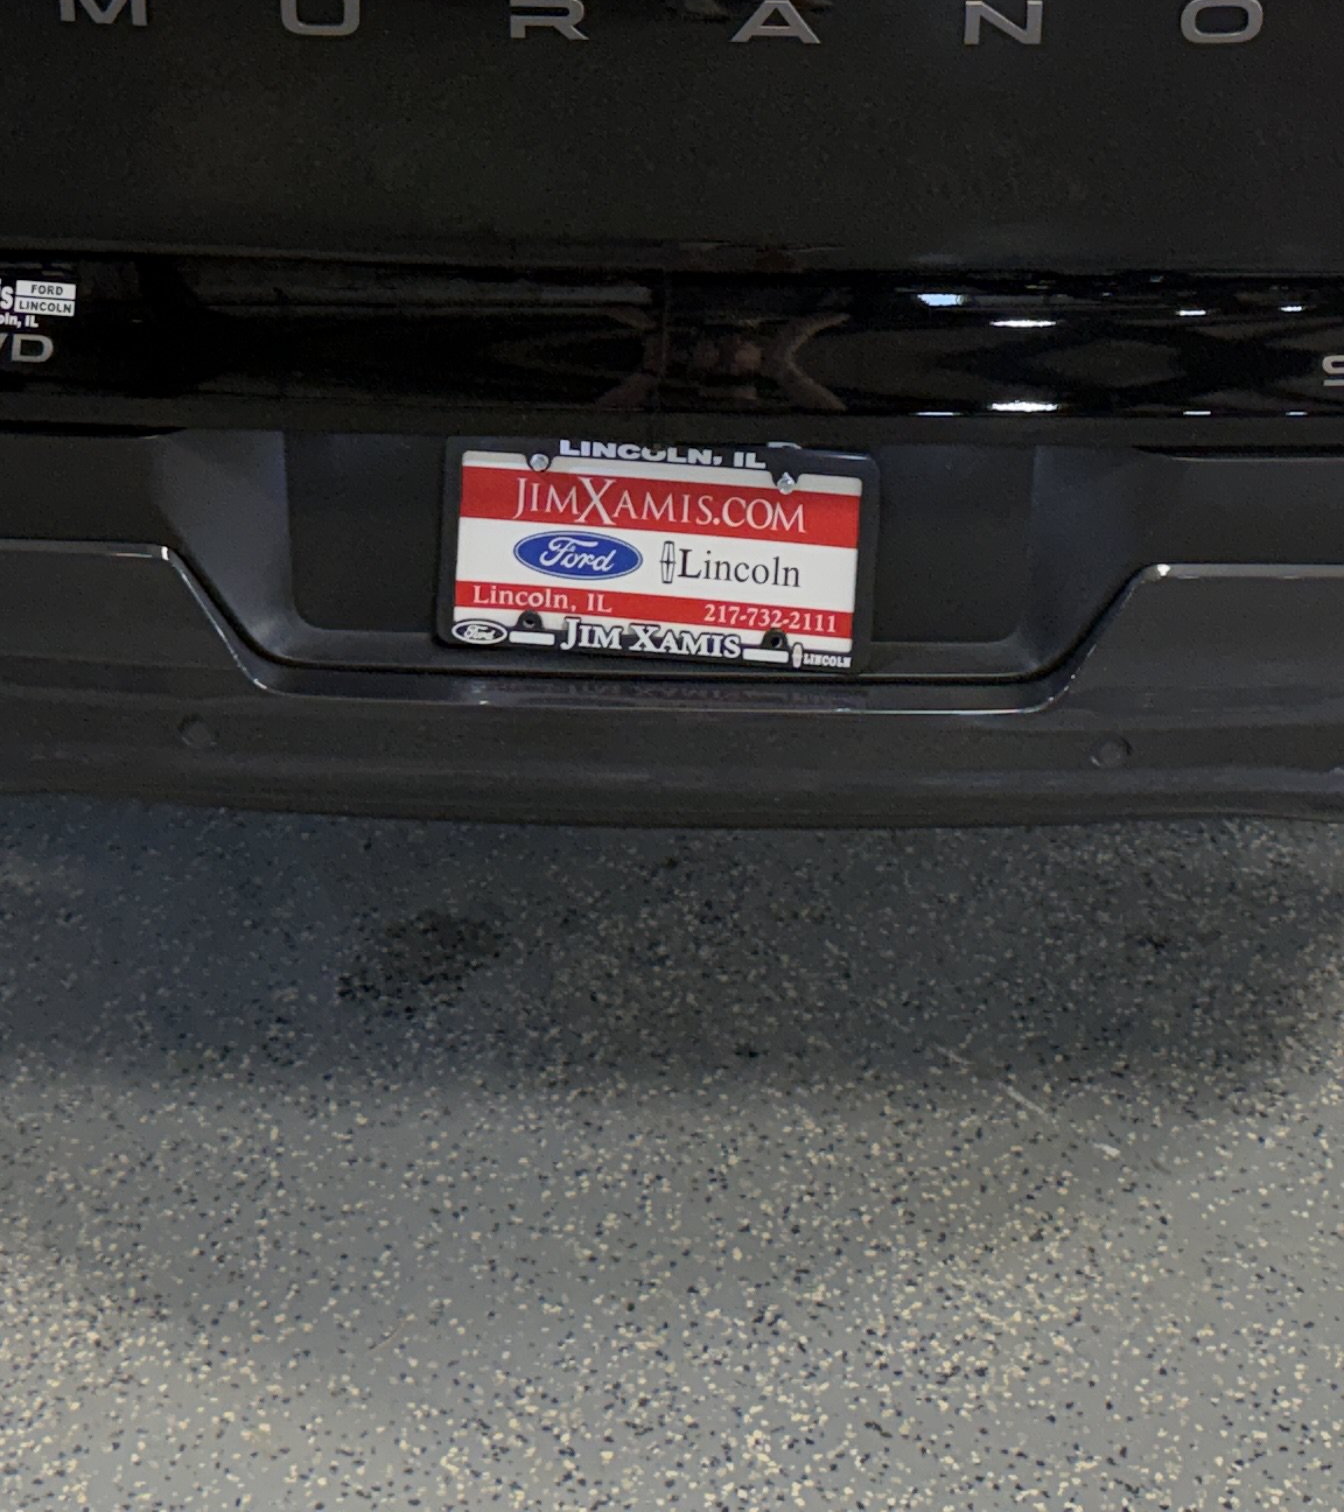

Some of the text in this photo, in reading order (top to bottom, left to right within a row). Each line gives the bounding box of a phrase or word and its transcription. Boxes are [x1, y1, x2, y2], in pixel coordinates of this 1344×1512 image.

[30, 284, 64, 296] FORD
[18, 300, 72, 314] LINCOLN
[25, 315, 39, 328] IL
[559, 439, 766, 469] LINCOLN, IL
[539, 536, 615, 573] Ford
[678, 548, 800, 588] Lincoln
[472, 585, 613, 613] Lincoln, IL
[703, 603, 838, 633] 217-732-2111
[802, 652, 852, 668] LINCOLN
